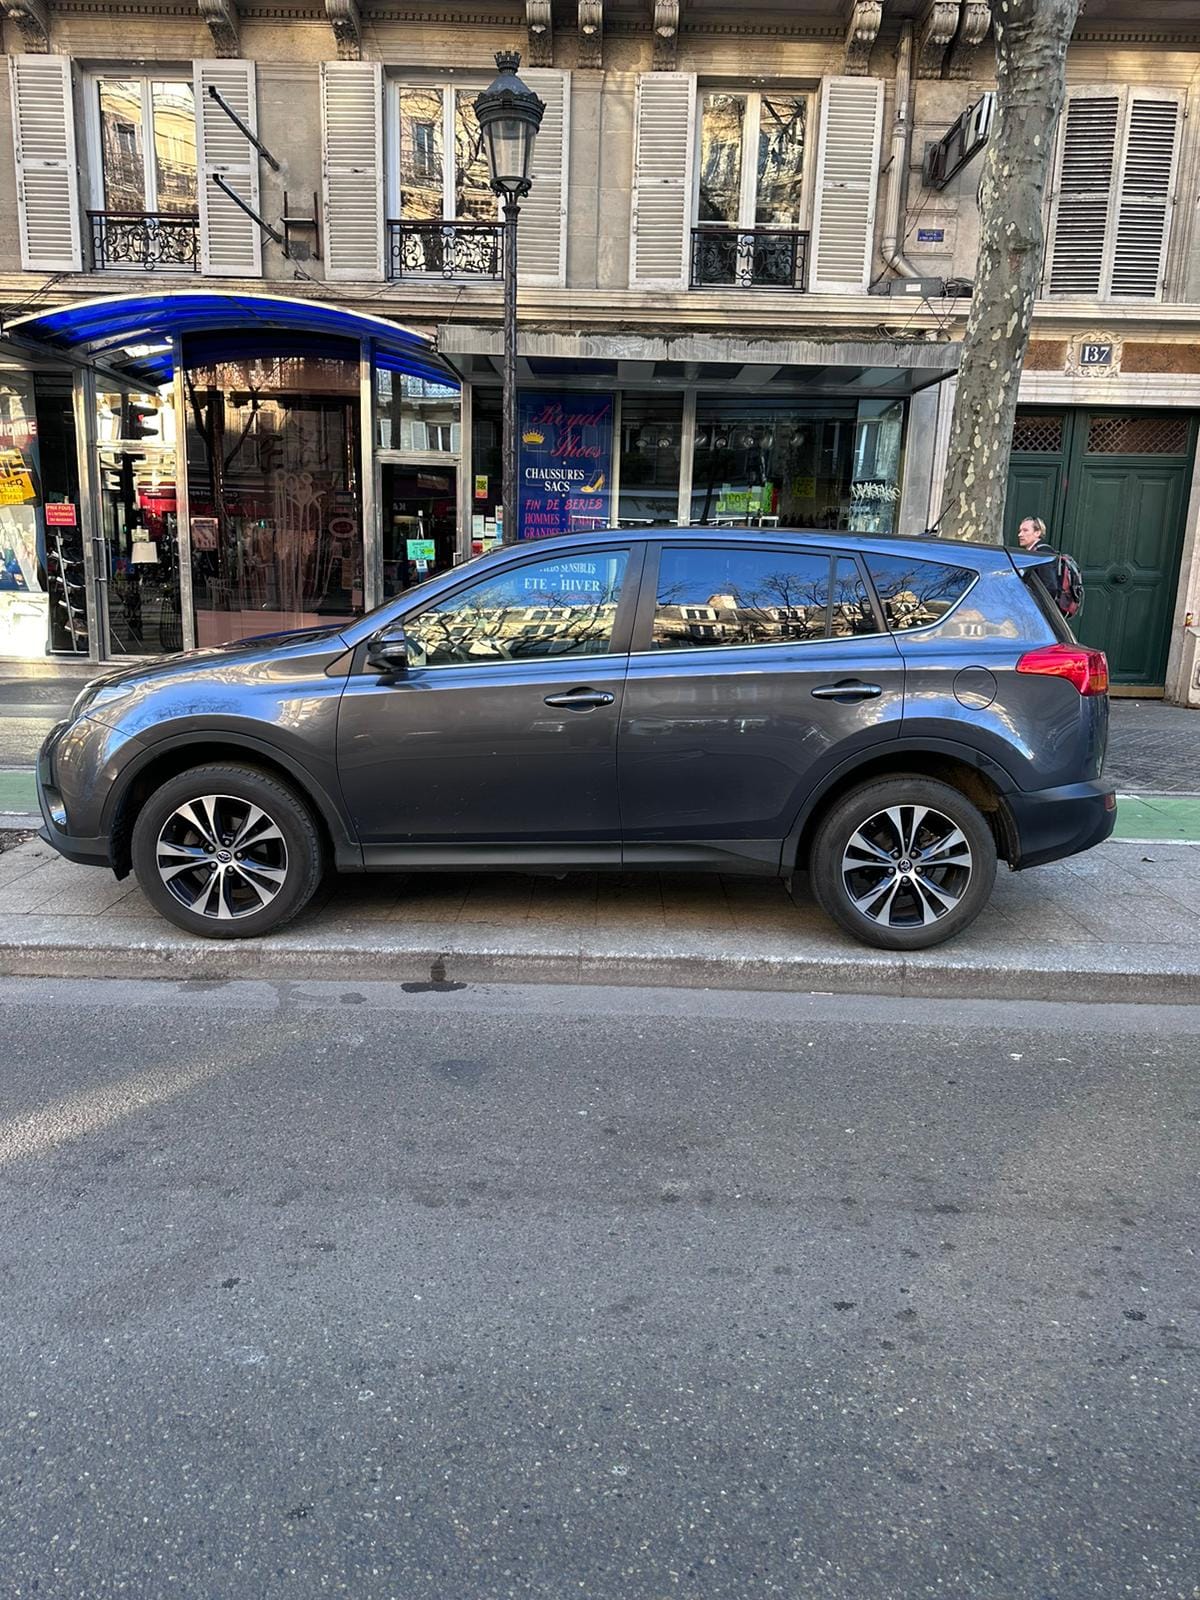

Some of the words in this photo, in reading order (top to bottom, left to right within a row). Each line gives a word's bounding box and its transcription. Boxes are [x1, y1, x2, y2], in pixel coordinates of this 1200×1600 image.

[1083, 346, 1110, 361] 137
[532, 403, 609, 435] Royal
[551, 434, 602, 458] Shoes
[525, 467, 585, 480] CHAUSSURES
[544, 480, 570, 492] SACS
[525, 499, 541, 510] FIN
[546, 499, 560, 510] DE
[525, 513, 560, 525] HOMMES
[561, 579, 600, 592] HIVER
